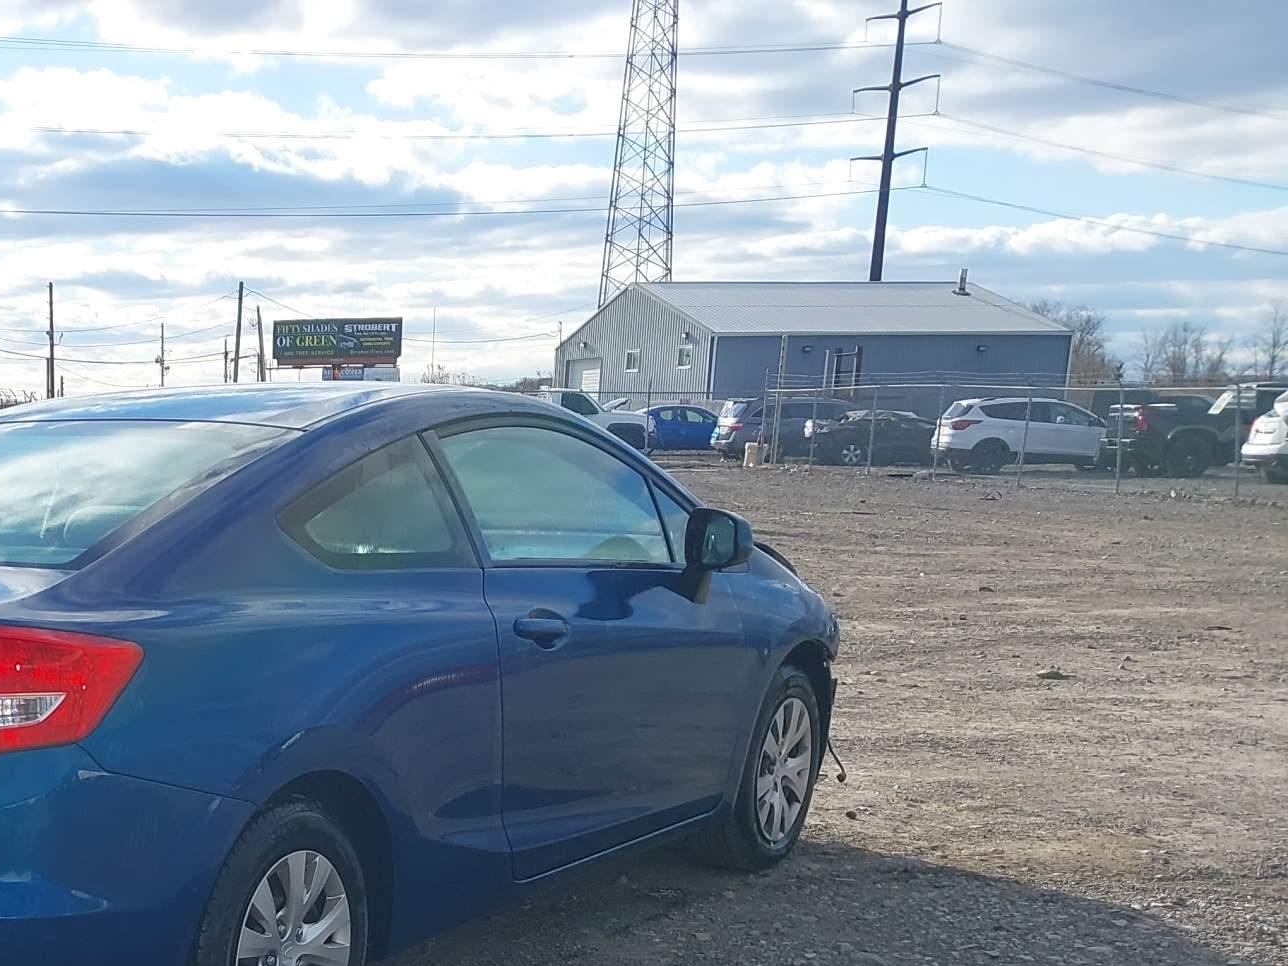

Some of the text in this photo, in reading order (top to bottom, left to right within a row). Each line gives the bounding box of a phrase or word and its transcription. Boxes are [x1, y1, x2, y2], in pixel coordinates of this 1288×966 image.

[277, 323, 338, 334] FIFTY SHADES
[344, 323, 398, 333] STROBERT
[276, 334, 337, 348] OF GREEN
